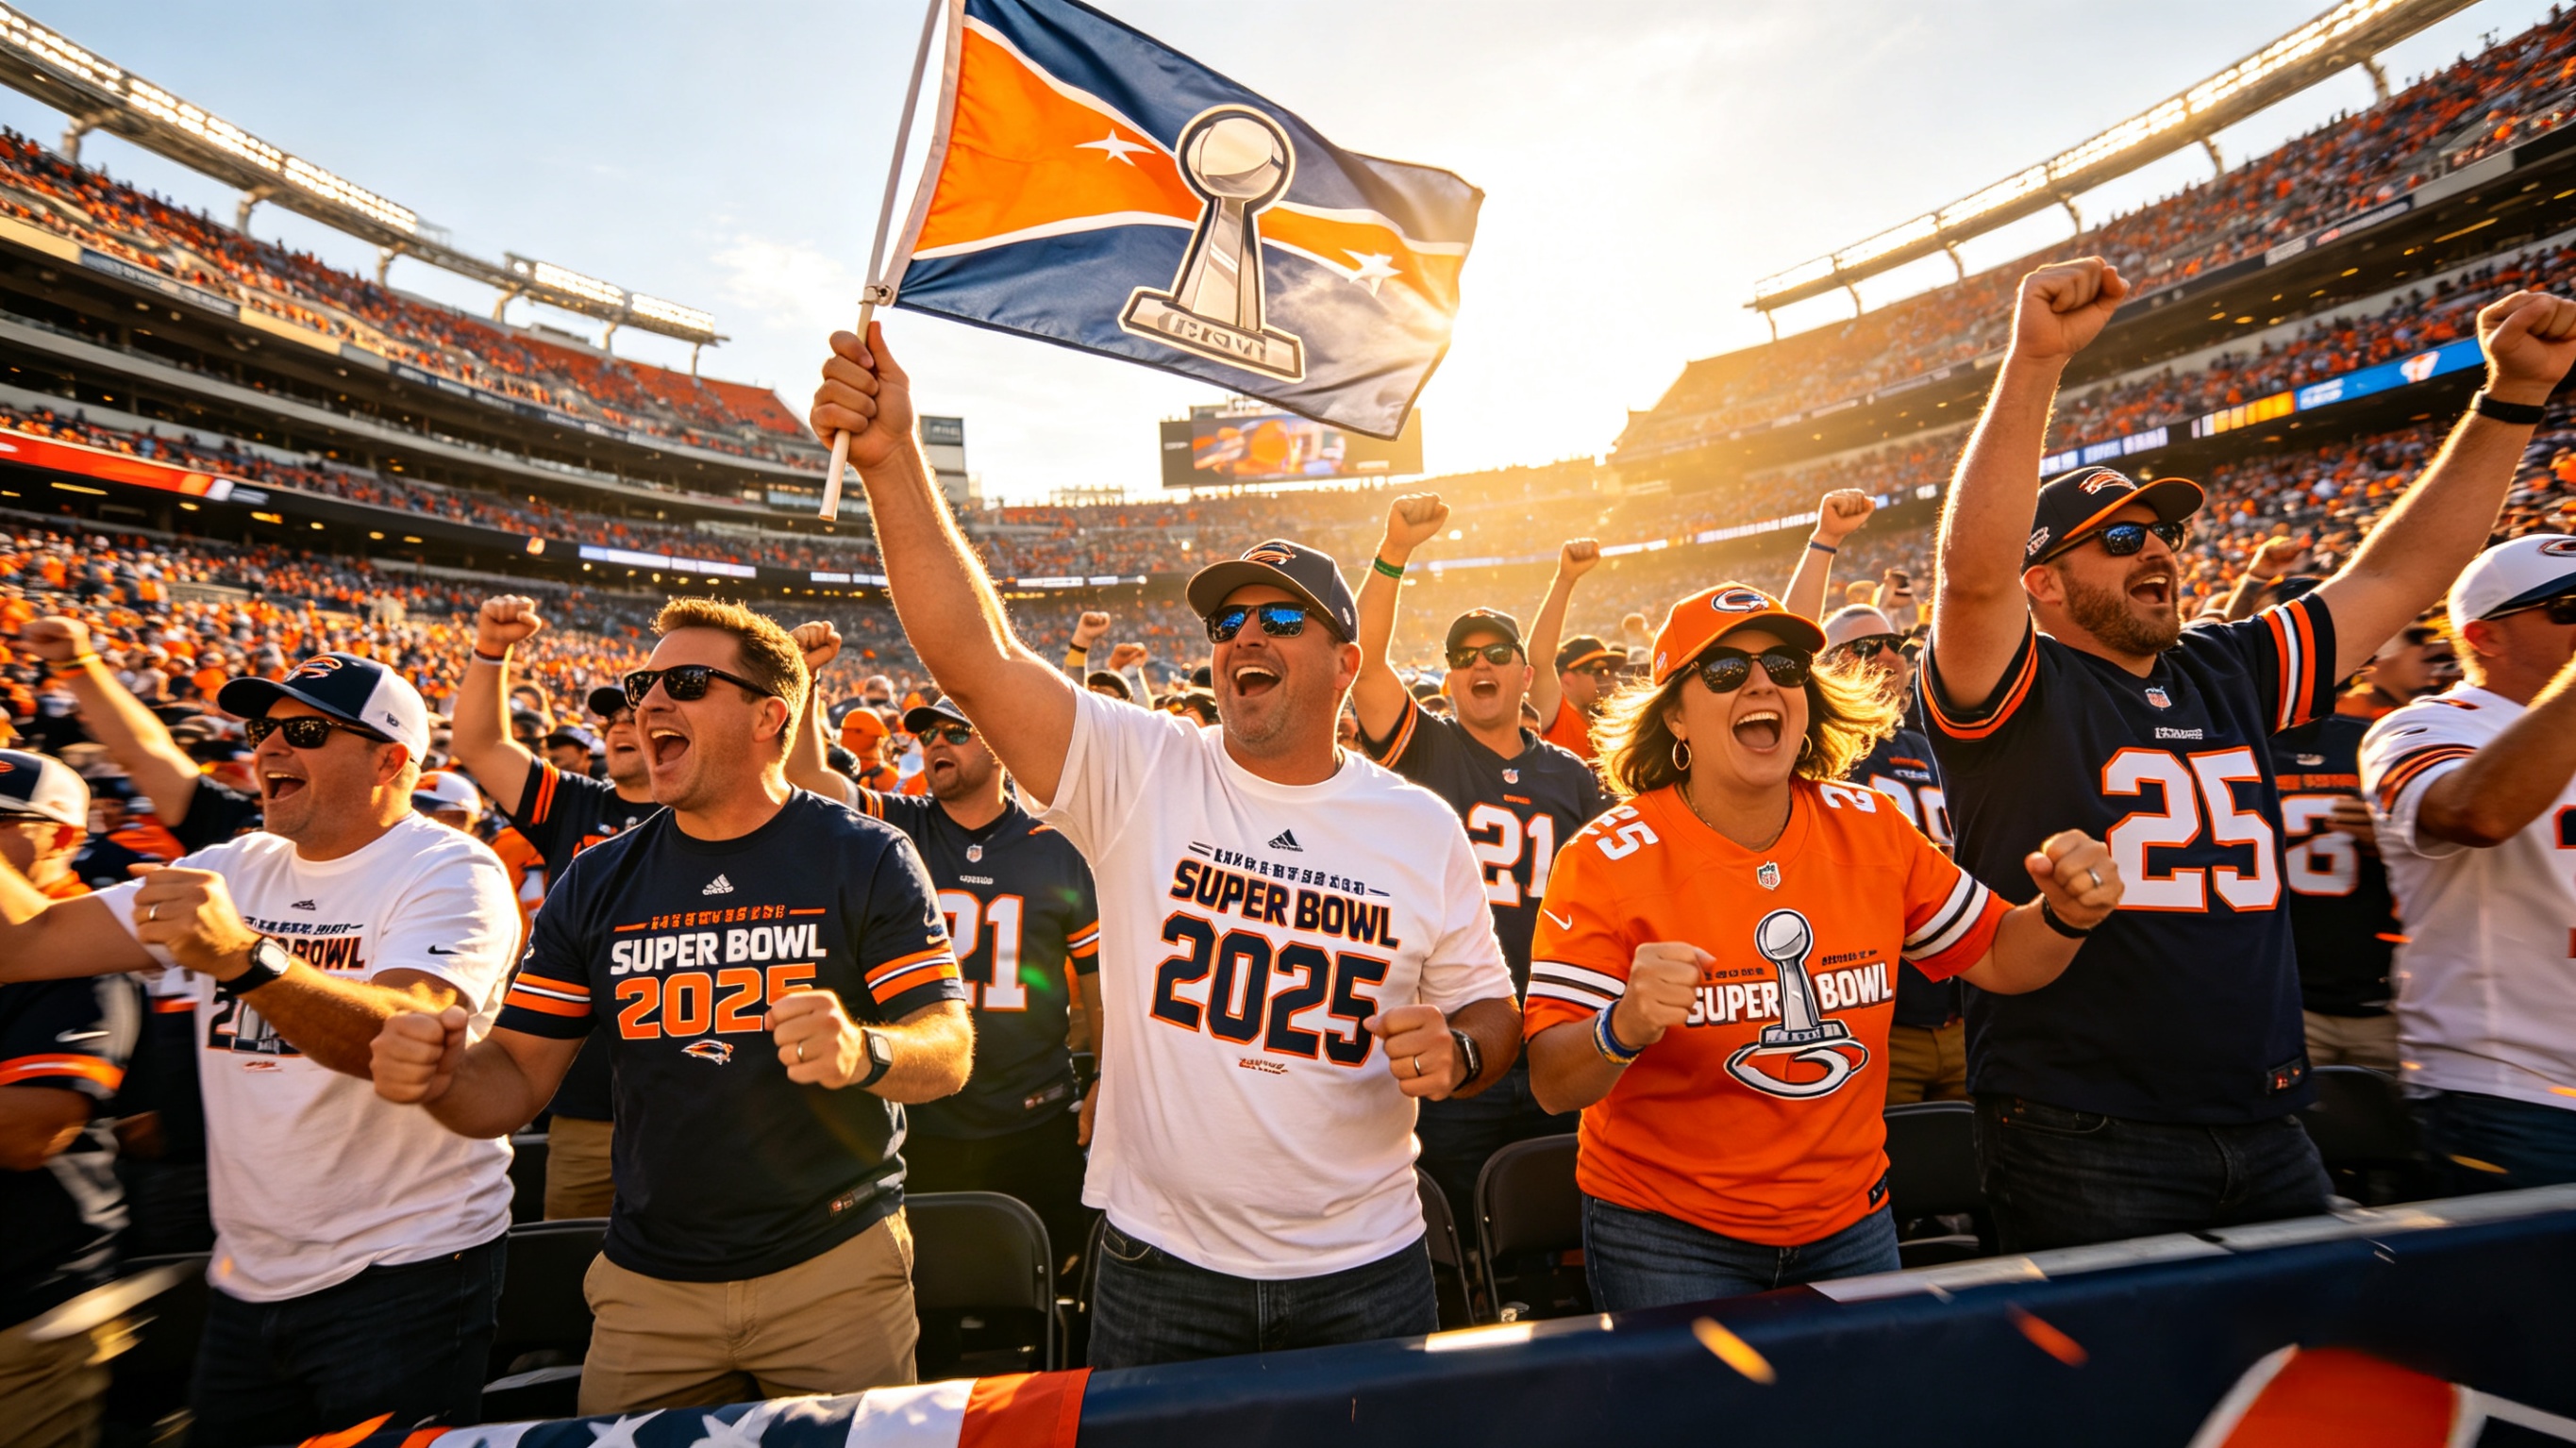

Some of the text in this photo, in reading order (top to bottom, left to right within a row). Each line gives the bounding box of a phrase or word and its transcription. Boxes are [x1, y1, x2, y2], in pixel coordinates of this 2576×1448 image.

[1467, 801, 1555, 908] 21
[2101, 745, 2282, 913] 25
[610, 924, 827, 975] SUPER BOWL
[1169, 857, 1290, 928] SUPER
[1293, 887, 1401, 951] BOWL
[1149, 910, 1391, 1068] 2025
[1813, 960, 1895, 1014] BOWL
